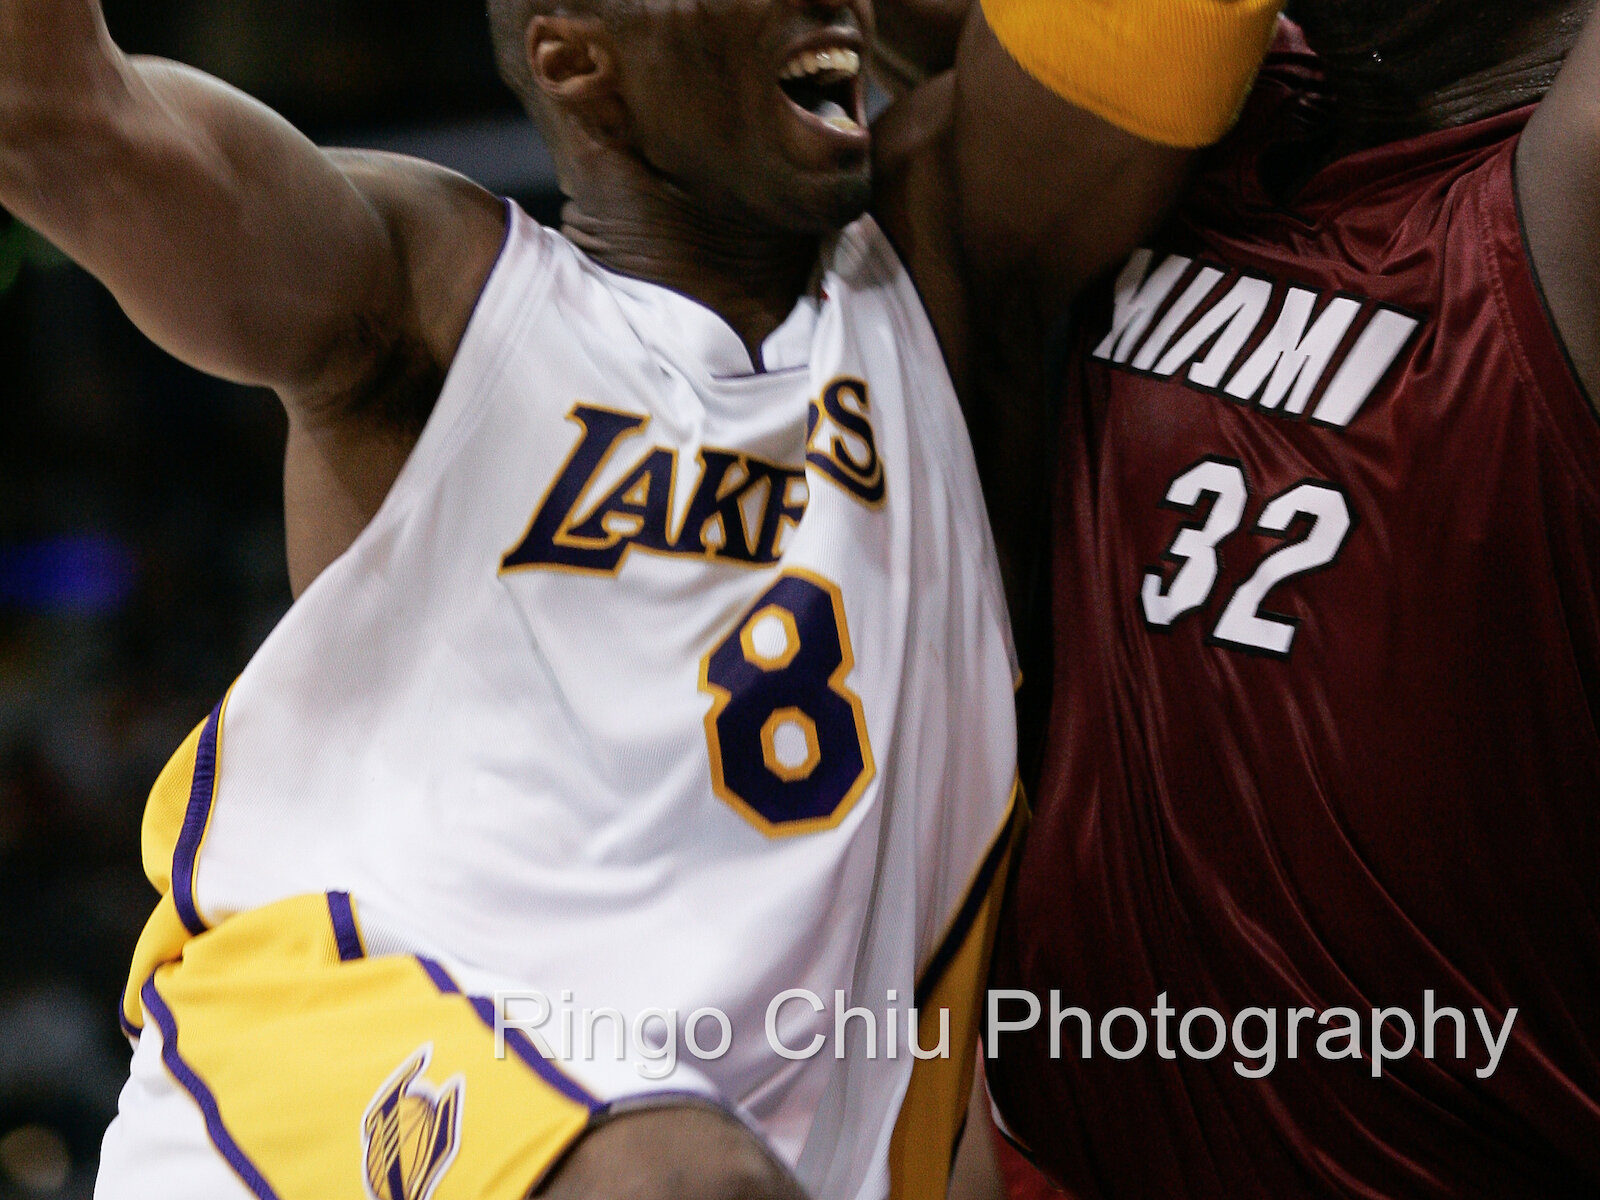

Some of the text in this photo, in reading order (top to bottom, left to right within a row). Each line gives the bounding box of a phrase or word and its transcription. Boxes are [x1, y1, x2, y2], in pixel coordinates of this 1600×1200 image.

[1091, 247, 1420, 427] MIAMI
[1139, 454, 1359, 657] 32
[698, 566, 876, 839] 8
